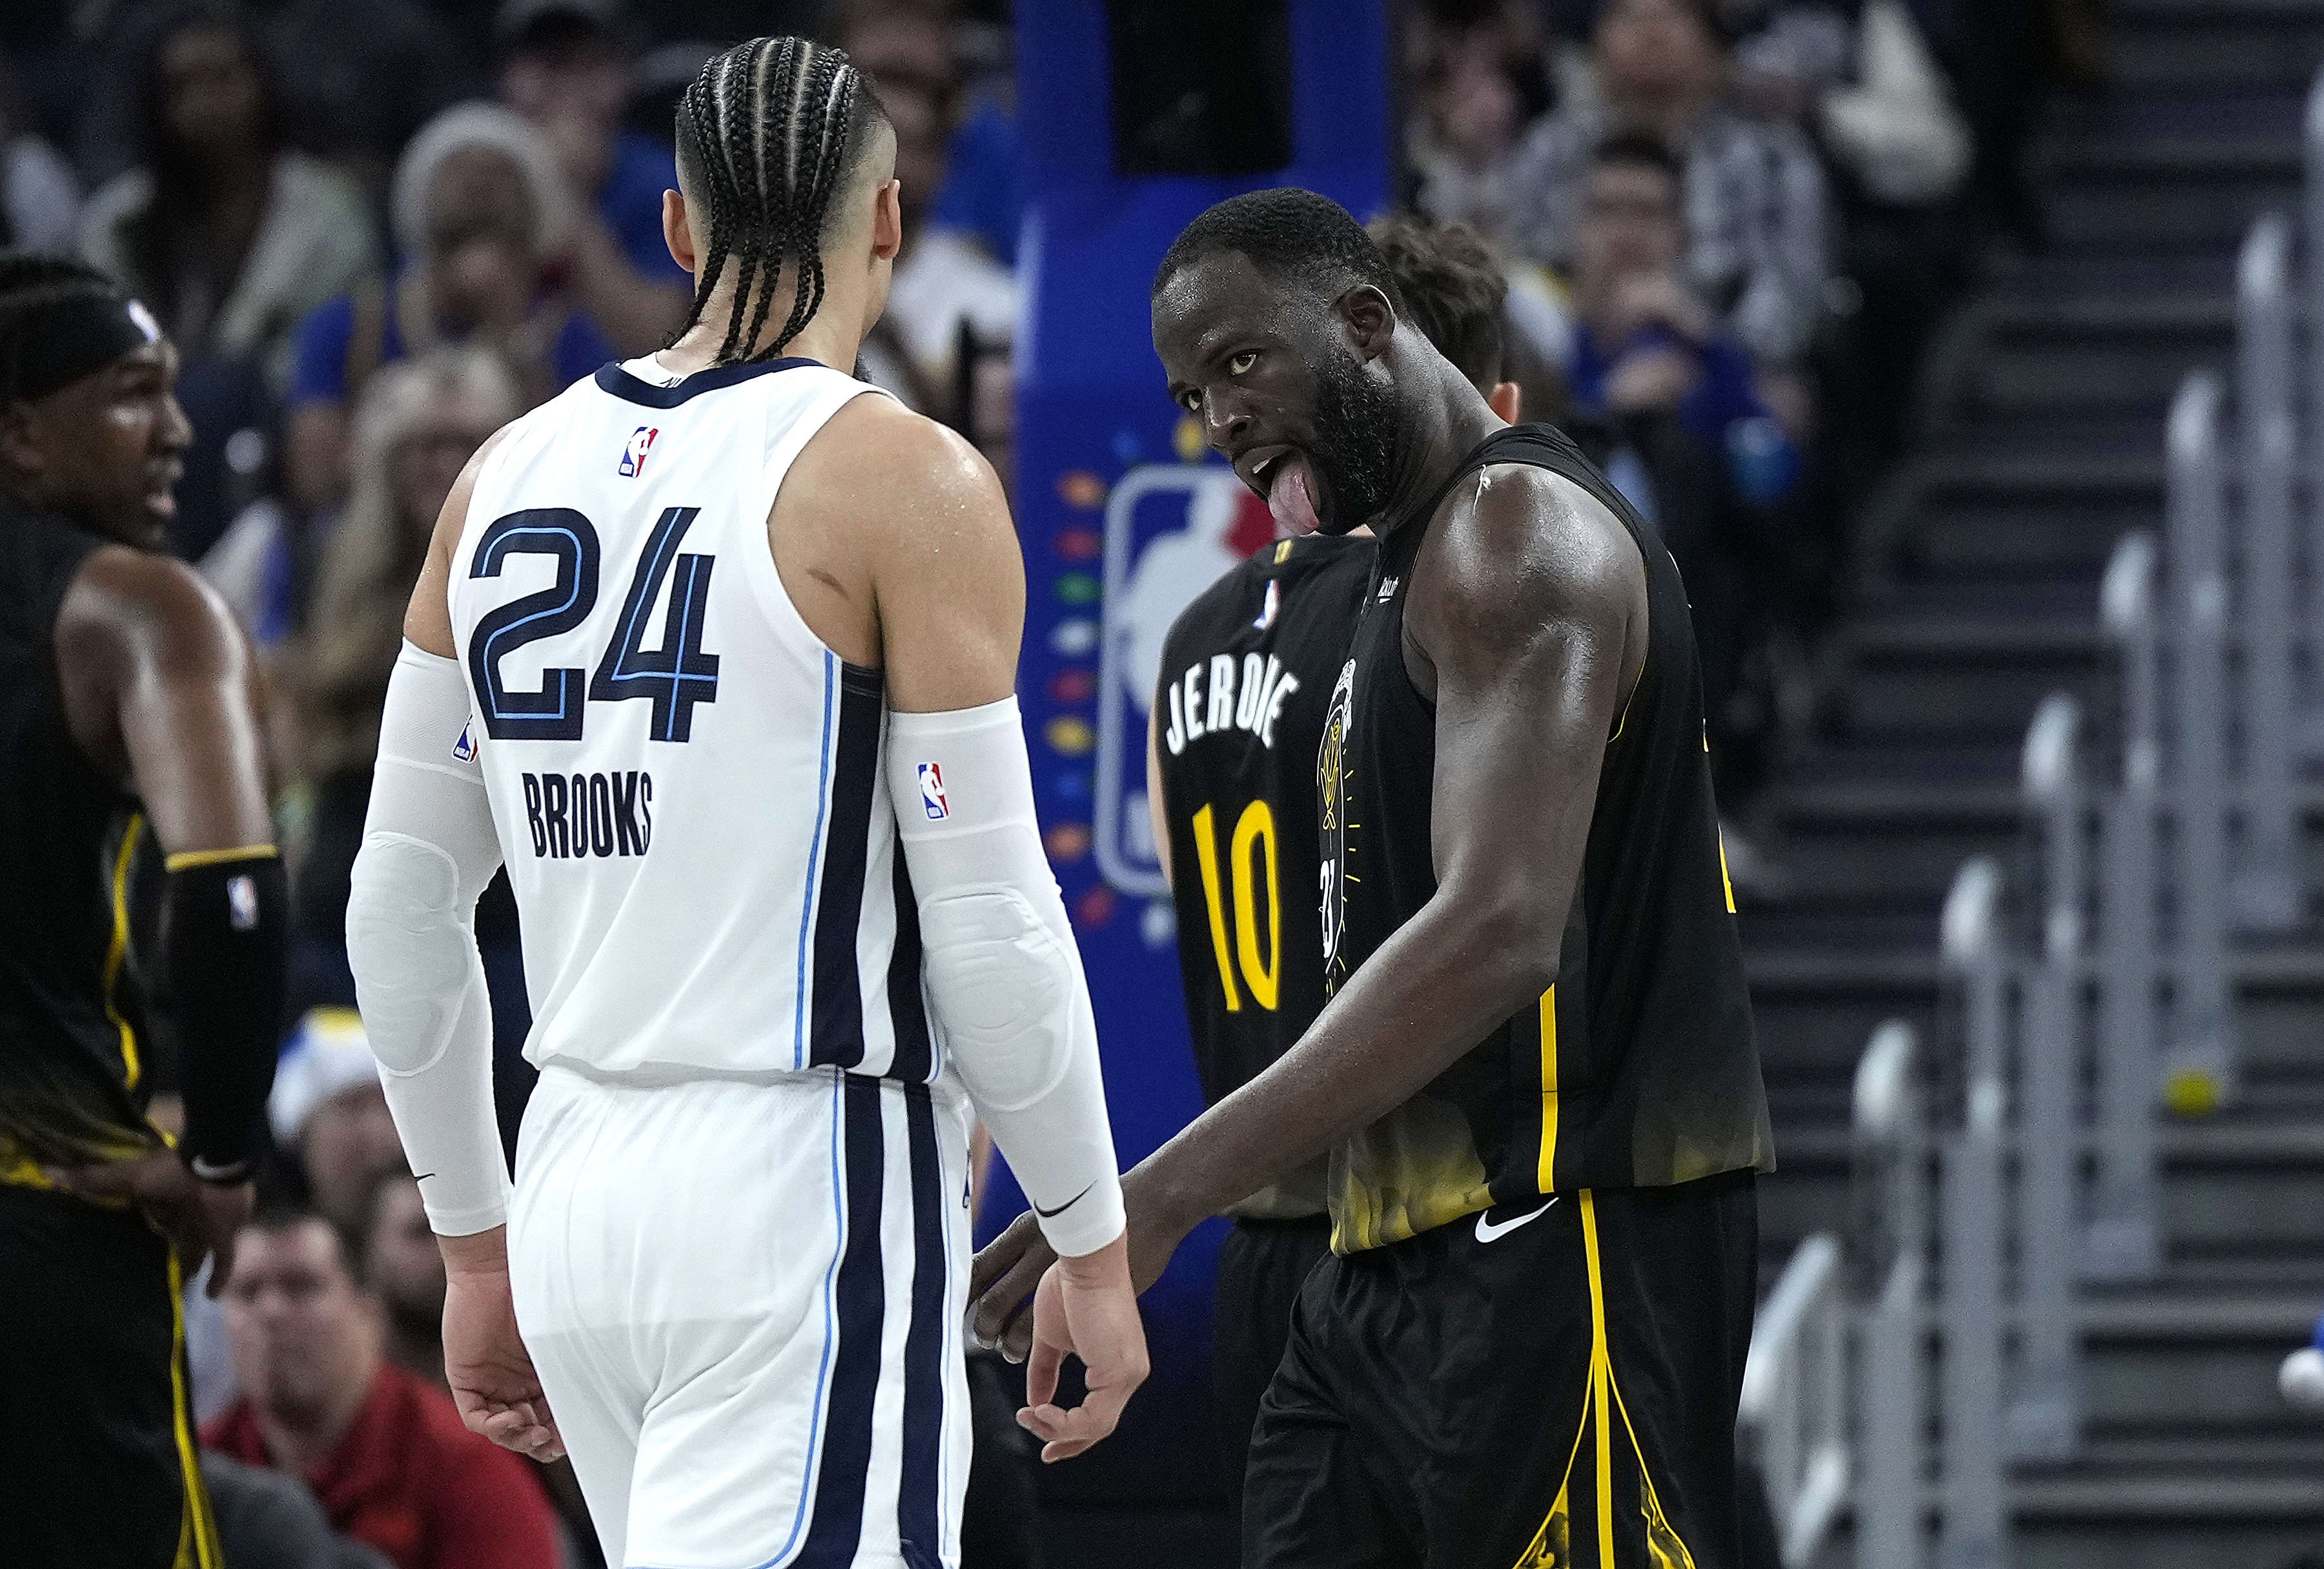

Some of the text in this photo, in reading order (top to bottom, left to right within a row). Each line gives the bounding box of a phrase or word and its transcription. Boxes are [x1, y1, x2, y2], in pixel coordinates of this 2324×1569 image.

[468, 506, 720, 743] 24
[522, 771, 653, 859] BROOKS
[1192, 799, 1280, 1012] 10
